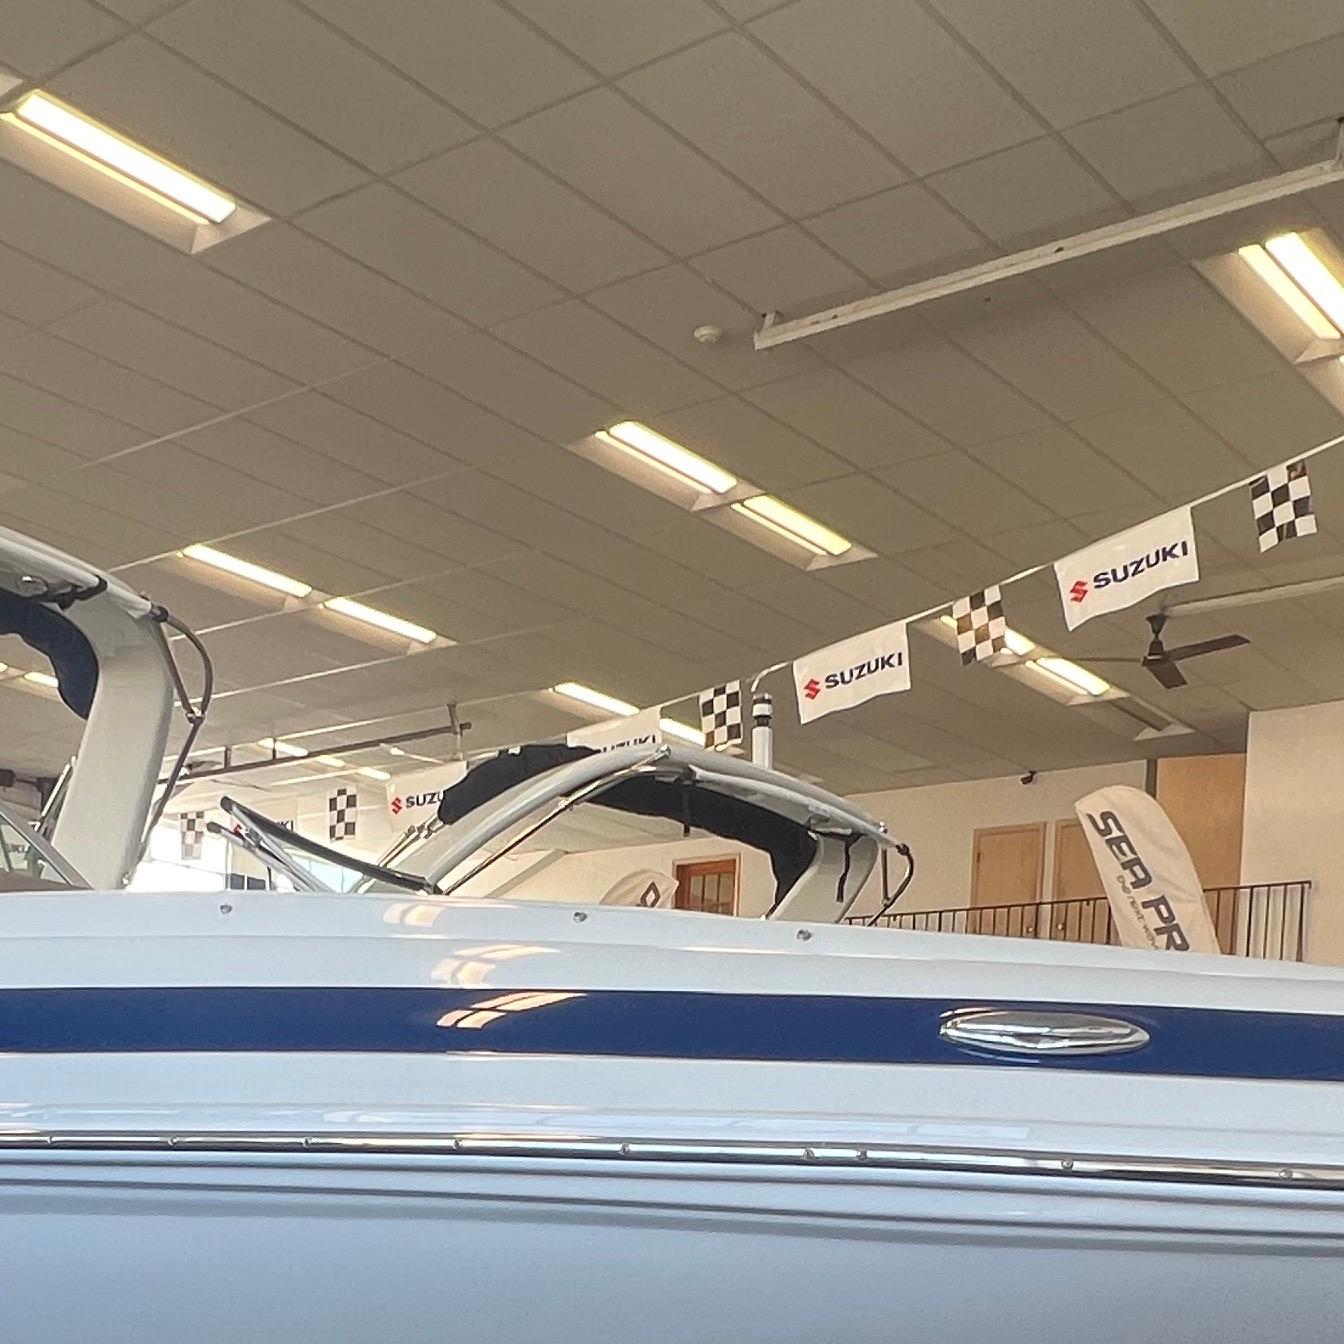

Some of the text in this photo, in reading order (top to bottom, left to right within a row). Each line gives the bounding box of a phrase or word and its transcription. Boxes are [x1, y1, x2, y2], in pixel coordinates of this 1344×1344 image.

[1093, 540, 1189, 589] SUZUKI
[824, 651, 903, 689] SUZUKI
[1086, 811, 1190, 951] SEA PR
